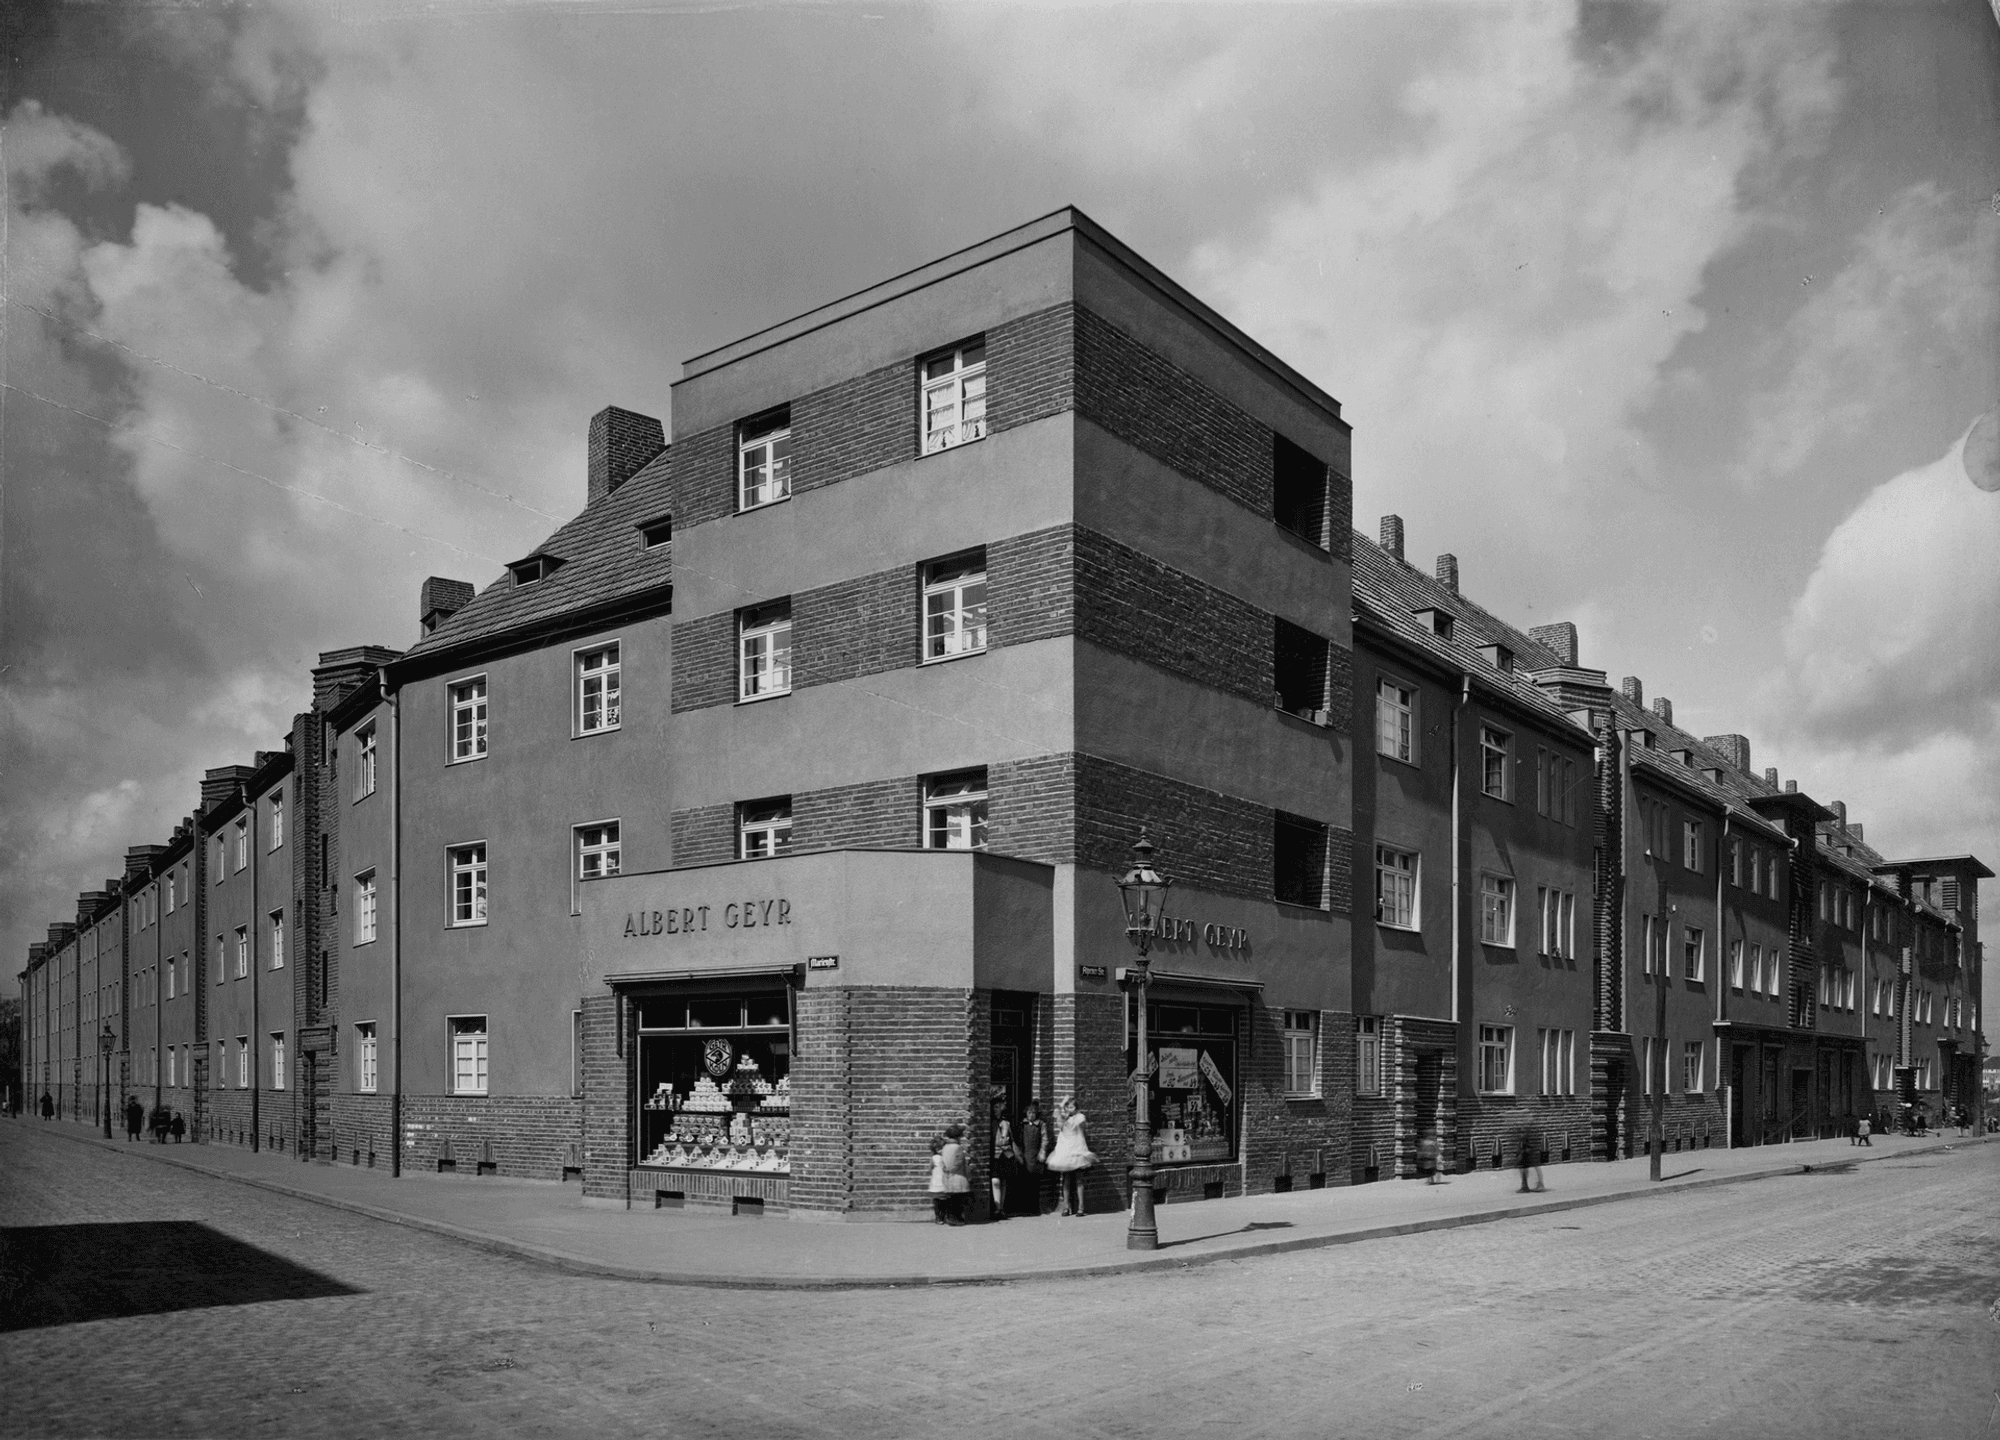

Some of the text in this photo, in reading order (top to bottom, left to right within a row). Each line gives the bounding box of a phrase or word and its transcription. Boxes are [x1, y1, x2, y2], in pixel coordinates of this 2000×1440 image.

[623, 899, 792, 938] ALBERT GEYR
[1203, 921, 1248, 949] GEYR
